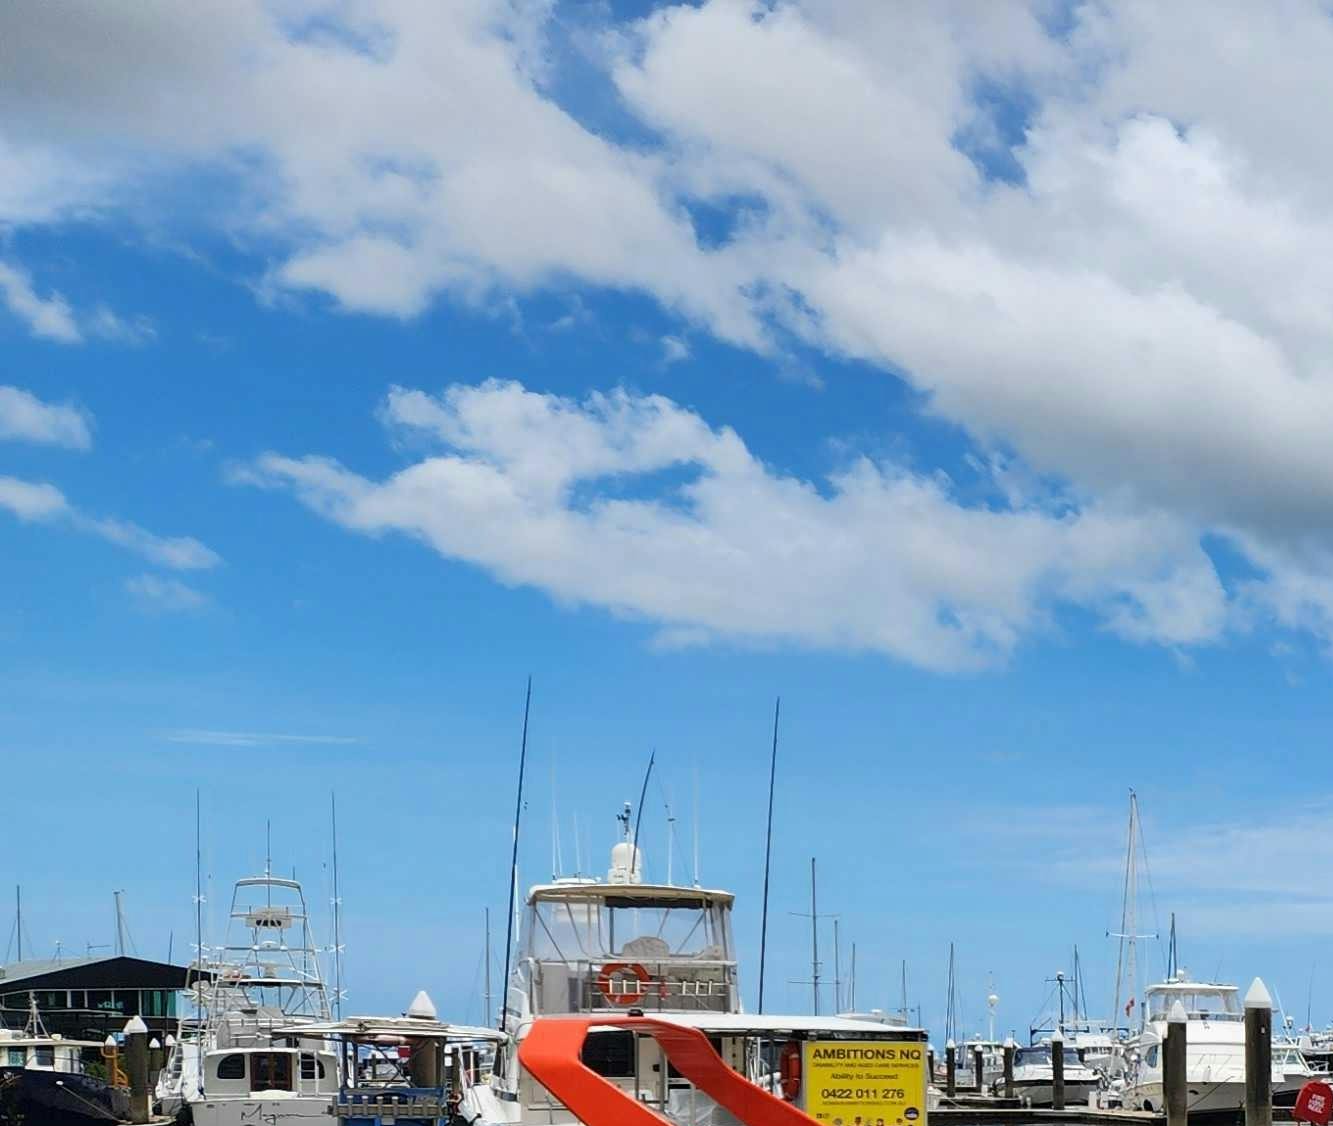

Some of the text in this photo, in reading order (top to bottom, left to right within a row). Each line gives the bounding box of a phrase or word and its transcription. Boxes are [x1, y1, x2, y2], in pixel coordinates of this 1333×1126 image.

[812, 1048, 922, 1061] AMBITIONS NQ
[830, 1072, 899, 1081] Ability to Succeed
[821, 1088, 905, 1099] 0422 011 276
